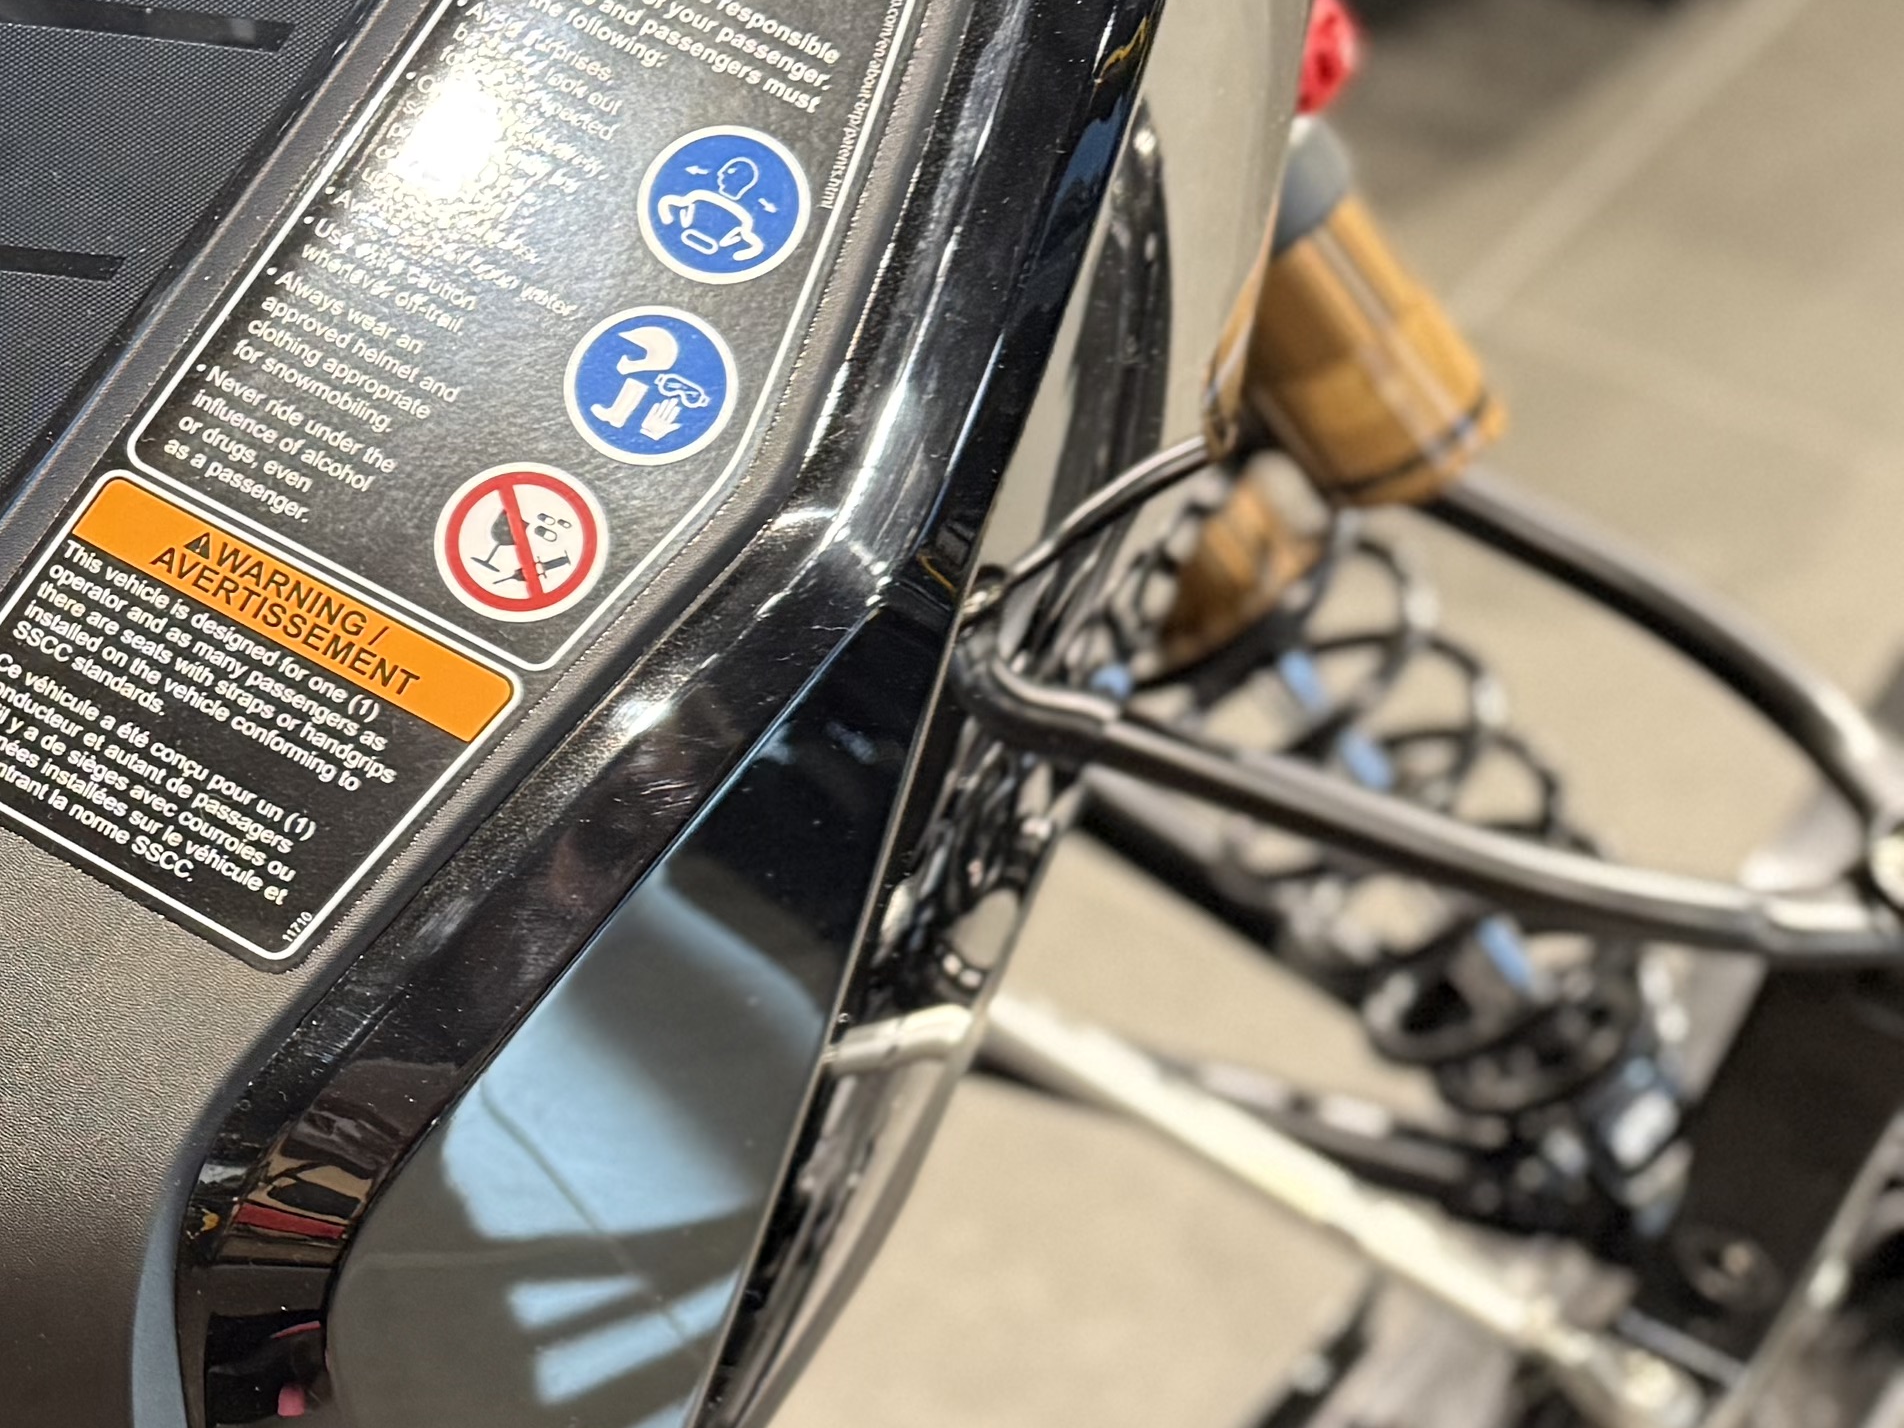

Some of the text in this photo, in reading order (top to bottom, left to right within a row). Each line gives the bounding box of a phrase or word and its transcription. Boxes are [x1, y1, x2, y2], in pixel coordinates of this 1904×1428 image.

[247, 319, 432, 420] clothing appropriate
[260, 295, 463, 403] approved helmet and
[273, 270, 427, 355] Always wear an
[190, 388, 376, 492] influence of alcohol
[204, 364, 398, 473] Never ride under the
[62, 538, 380, 724] This vehicle is designed for one (1)
[148, 546, 421, 695] AVERTISSEMENT
[215, 541, 367, 637] WARNING
[35, 579, 397, 784] there are seats with straps or handgrips
[48, 563, 388, 752] operator and as many passengers as
[23, 670, 100, 721] véhicule
[98, 713, 117, 731] a
[115, 720, 150, 749] été
[148, 741, 210, 782] conçu
[205, 772, 258, 805] pour
[254, 797, 285, 822] un
[282, 811, 316, 842] (1)
[81, 731, 106, 752] et
[102, 743, 167, 785] autant
[164, 776, 194, 799] de
[189, 791, 294, 854] passagers
[40, 758, 129, 815] installées
[129, 809, 164, 837] sur
[163, 825, 184, 848] le
[184, 838, 264, 892] véhicule
[262, 884, 289, 906] et
[280, 907, 316, 946] 11710
